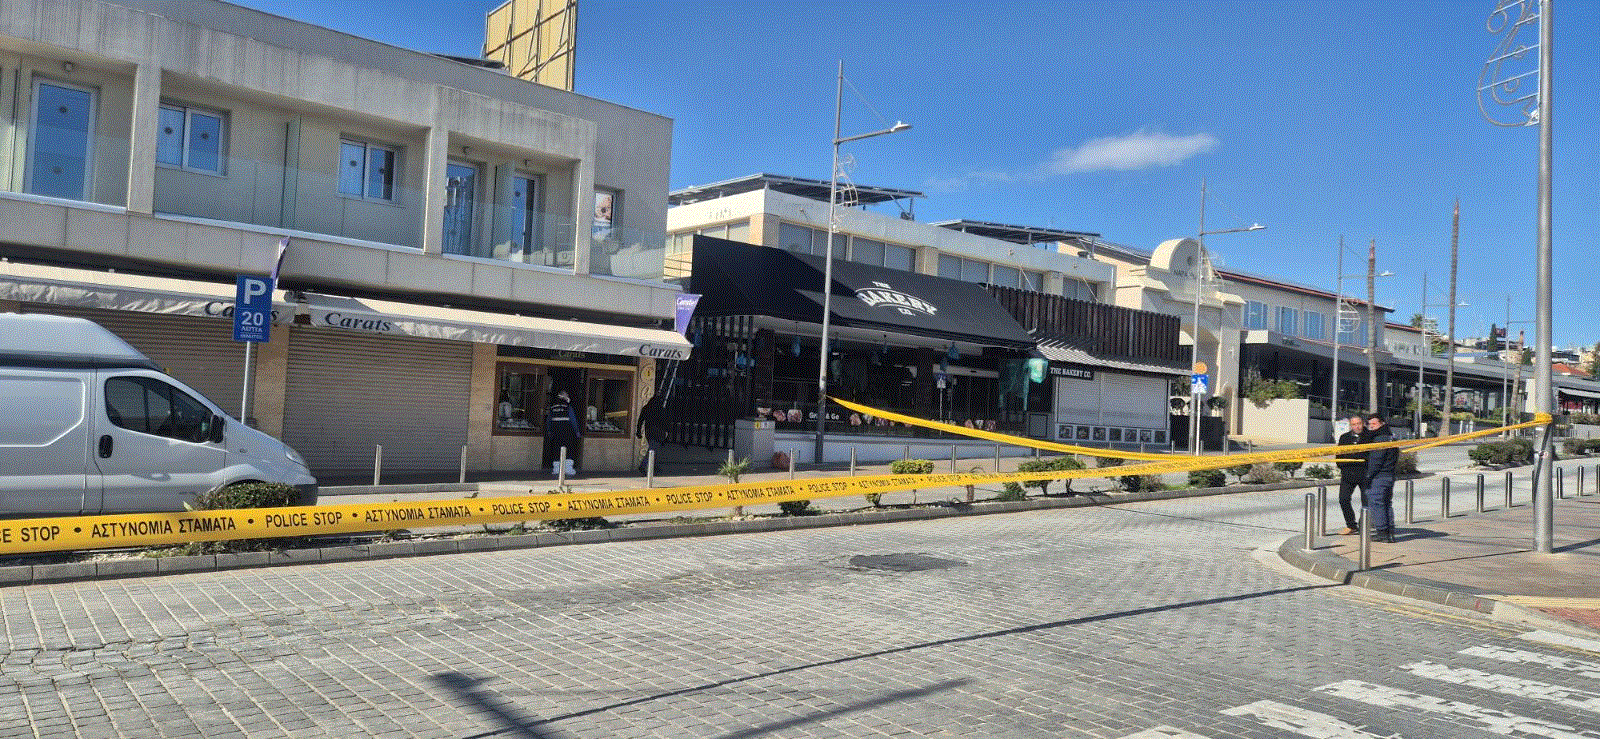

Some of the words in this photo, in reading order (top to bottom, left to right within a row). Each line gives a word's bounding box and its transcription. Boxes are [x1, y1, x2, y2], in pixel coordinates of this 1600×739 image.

[244, 278, 267, 305] P
[872, 280, 892, 290] THE
[205, 301, 280, 321] Cas
[856, 290, 938, 316] BAKERY
[241, 311, 264, 326] 20
[897, 307, 916, 317] CO.
[325, 312, 392, 331] Carats
[639, 344, 683, 359] Carats
[1050, 367, 1061, 375] THE
[1062, 368, 1084, 378] BAKERY
[0, 527, 12, 543] E
[21, 525, 60, 542] STOP
[91, 519, 173, 538] ΑΣΤΥΝΟΜΙΑ
[178, 517, 236, 534] ΣΤΑΜΑΤΑ
[265, 513, 308, 528] POLICE
[314, 511, 343, 526] STOP
[365, 507, 425, 523] ΑΣΤΥΝΟΜΙΑ
[428, 505, 472, 519] ΣΤΑΜΑΤΑ
[492, 503, 525, 515] POLICE
[528, 501, 551, 513] STOP
[567, 498, 613, 511] ΑΣΤΥΝΟΜΙΑ
[615, 496, 651, 509] ΣΤΑΜΑΤΑ
[665, 493, 694, 505] POLICE
[694, 491, 713, 503] STOP
[726, 487, 765, 500] ΑΣΤΥΝΟΜΙΑ
[766, 485, 795, 497] ΣΤΑΜΑΤΑ
[807, 483, 832, 493] POLICE
[832, 481, 848, 492] STOP
